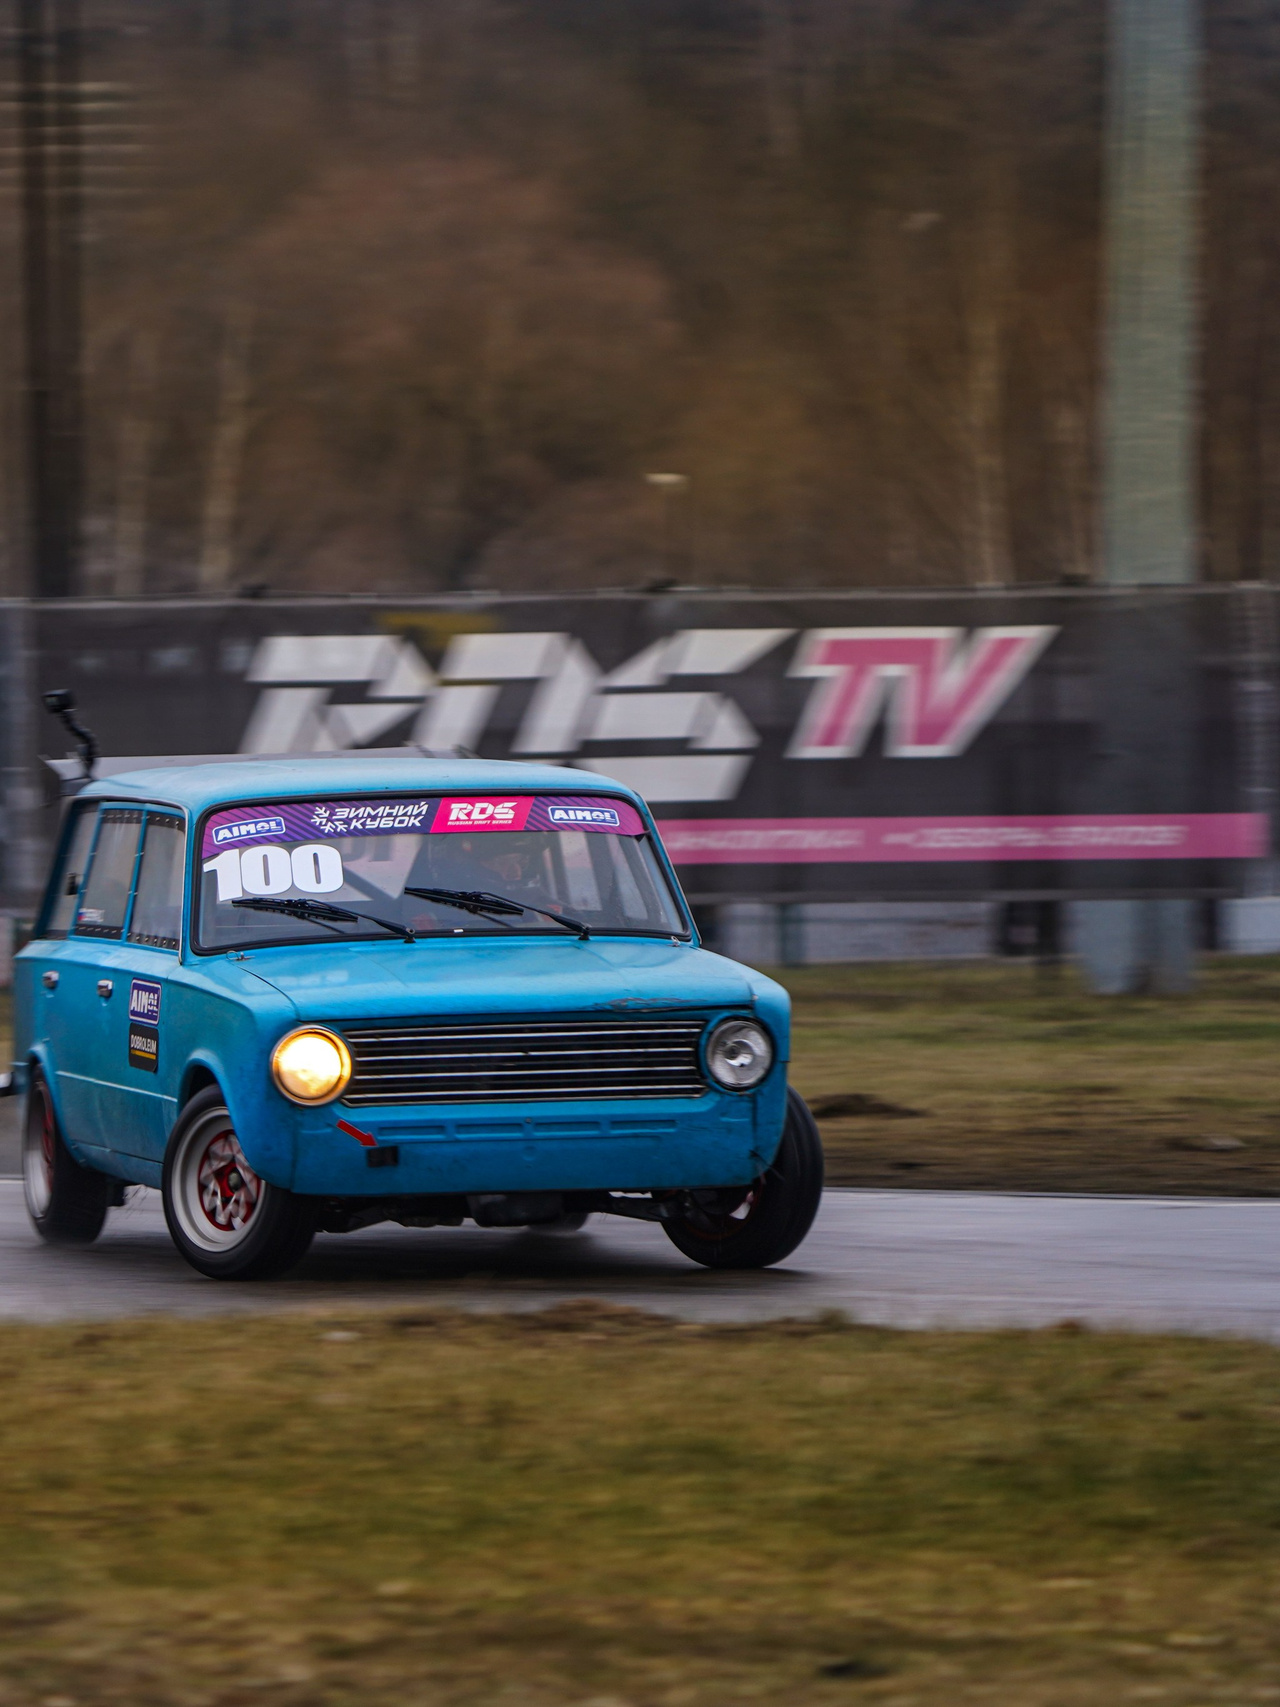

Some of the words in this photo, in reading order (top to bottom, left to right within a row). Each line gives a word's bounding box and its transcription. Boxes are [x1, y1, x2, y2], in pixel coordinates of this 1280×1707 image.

[786, 624, 1062, 760] TV
[332, 802, 428, 820] ЗИМНИЙ
[449, 802, 517, 821] RDS
[552, 808, 615, 822] AIMOL
[216, 820, 282, 840] AIMOL
[349, 815, 425, 830] КУБОК
[203, 844, 344, 901] 100
[130, 989, 158, 1014] AIMOL
[130, 1034, 157, 1054] DOBROLEUM
